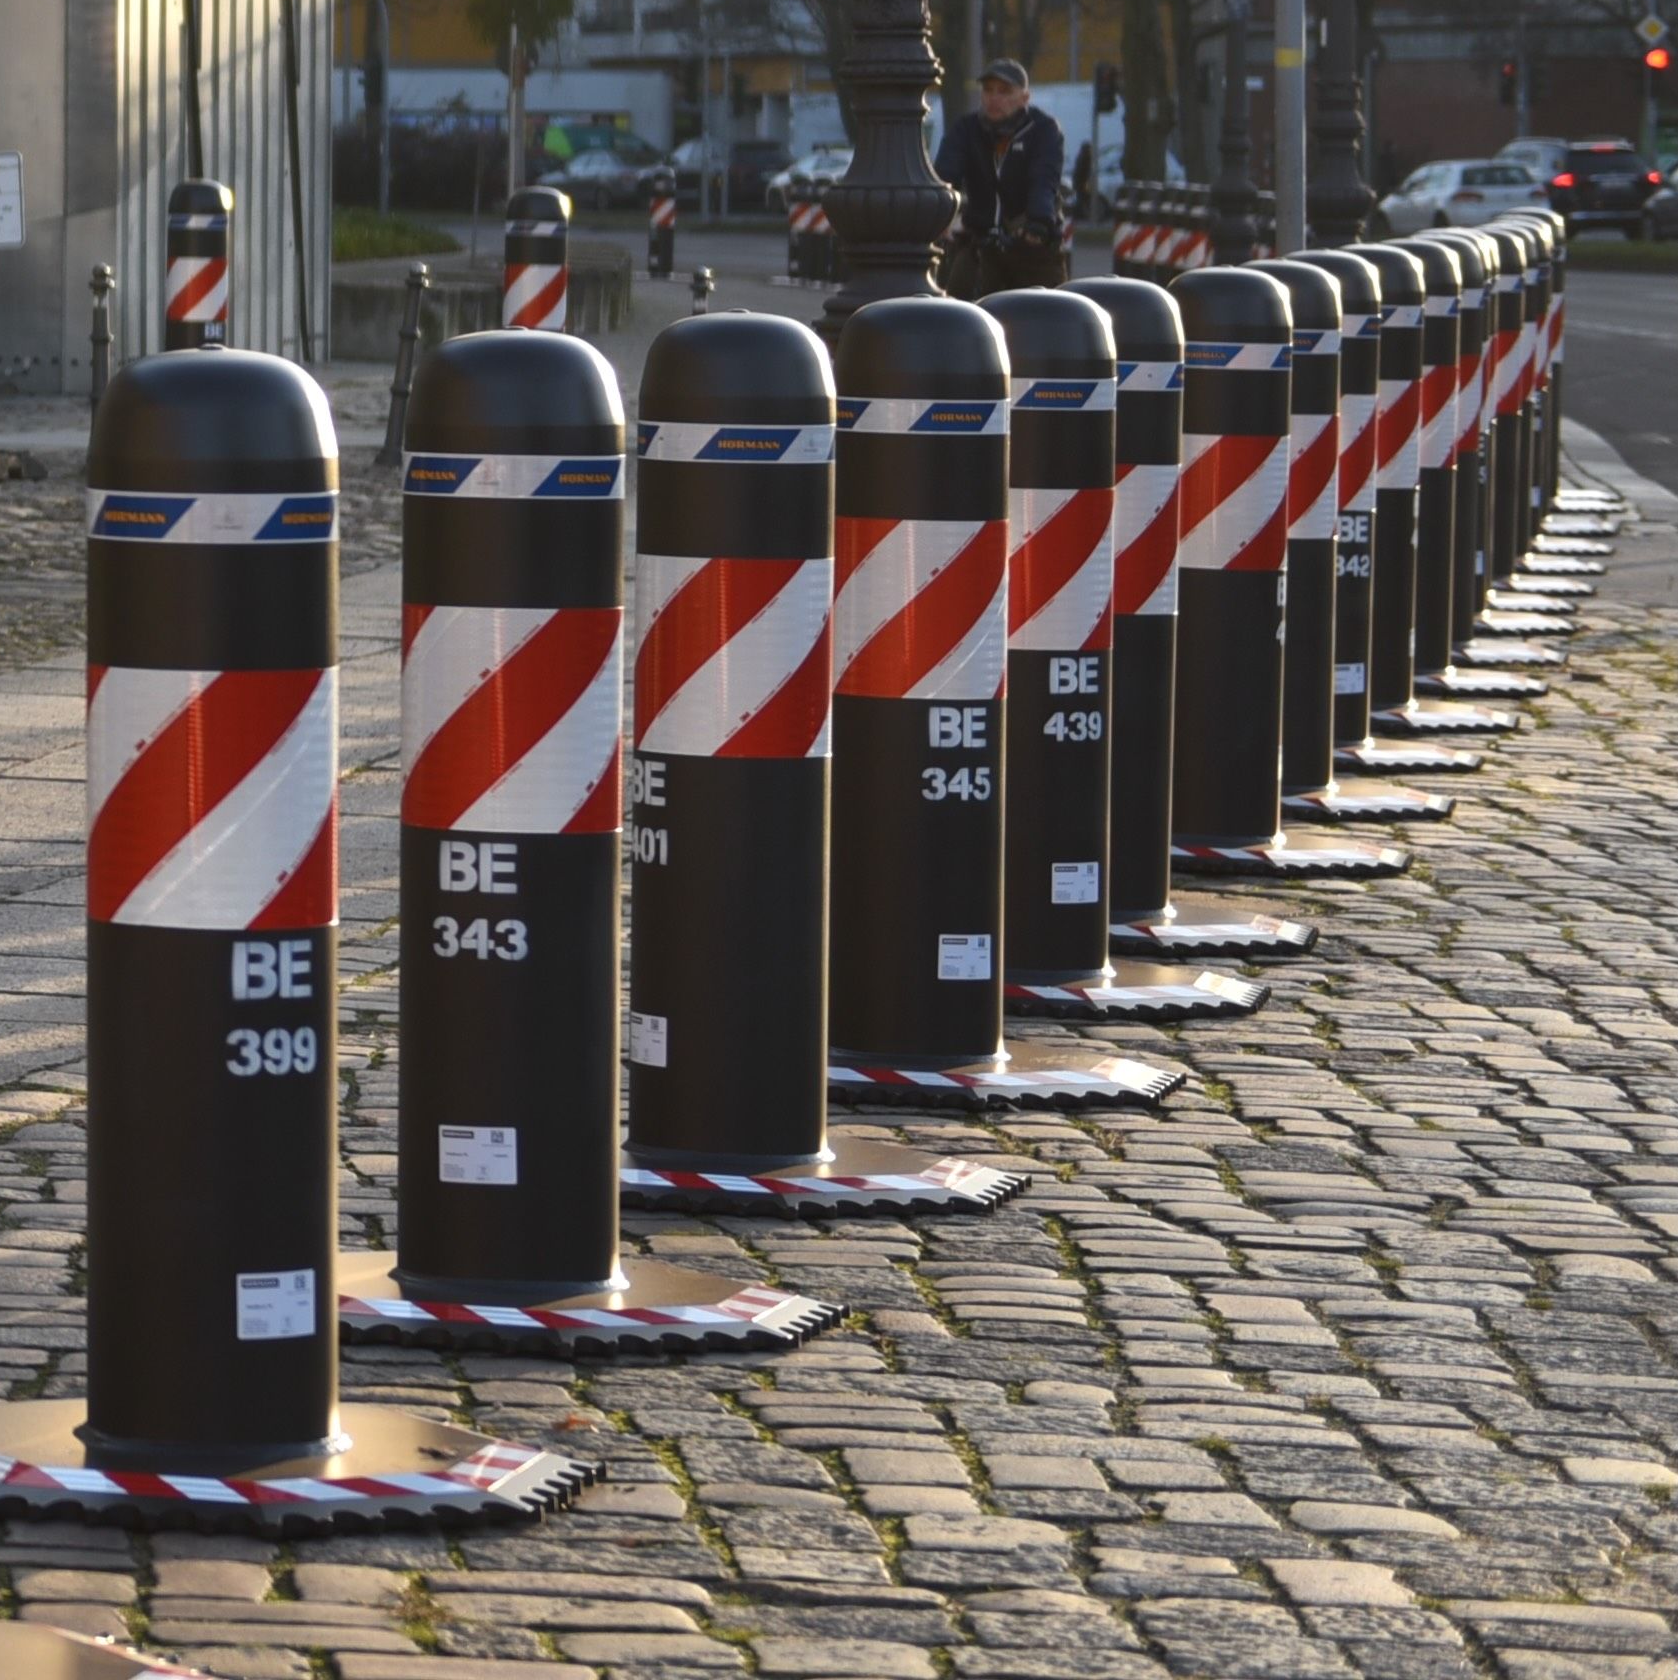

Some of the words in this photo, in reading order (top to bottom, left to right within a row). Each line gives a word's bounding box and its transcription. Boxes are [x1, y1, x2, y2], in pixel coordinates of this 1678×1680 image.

[1338, 515, 1369, 543] BE
[1049, 657, 1100, 695] BE
[928, 707, 988, 750] BE
[1043, 711, 1103, 743] 439
[921, 767, 991, 802] 345
[439, 840, 518, 894] BE
[433, 915, 529, 961] 343
[231, 939, 313, 1001] BE
[226, 1027, 318, 1076] 399
